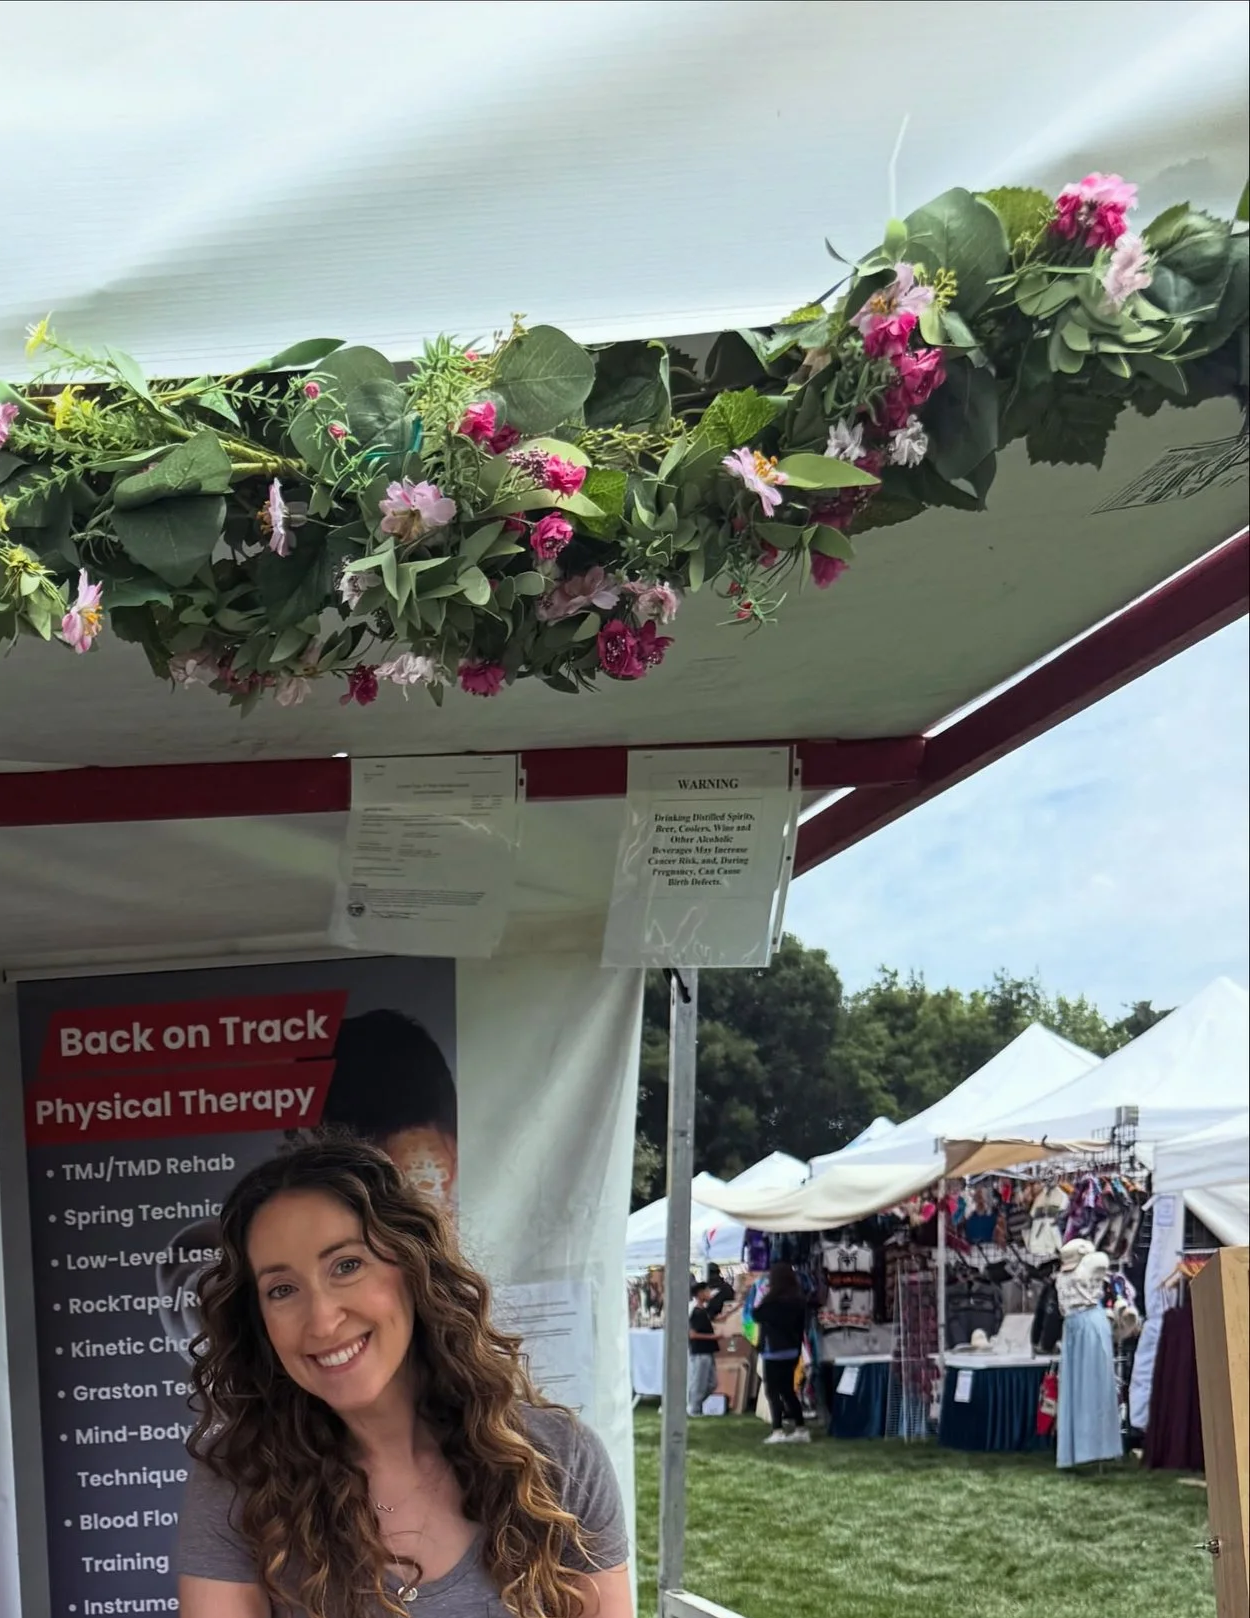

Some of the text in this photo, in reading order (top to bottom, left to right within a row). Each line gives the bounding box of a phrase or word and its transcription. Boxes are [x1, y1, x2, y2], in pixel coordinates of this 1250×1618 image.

[678, 778, 739, 790] WARNING
[654, 814, 690, 822] Drinking
[692, 813, 726, 821] Distilled
[60, 1009, 329, 1057] Back on Track
[36, 1087, 315, 1130] Physical Therapy
[62, 1153, 235, 1182] TMJ/TMD Rehab
[64, 1199, 224, 1230] Spring Techni
[67, 1247, 173, 1271] Low-Level
[71, 1338, 144, 1358] Kinetic
[73, 1382, 157, 1401] Graston
[75, 1422, 192, 1445] Mind-Body
[77, 1467, 188, 1488] Technique
[79, 1512, 139, 1530] Blood
[82, 1553, 170, 1573] Training
[84, 1596, 180, 1615] Instrume
